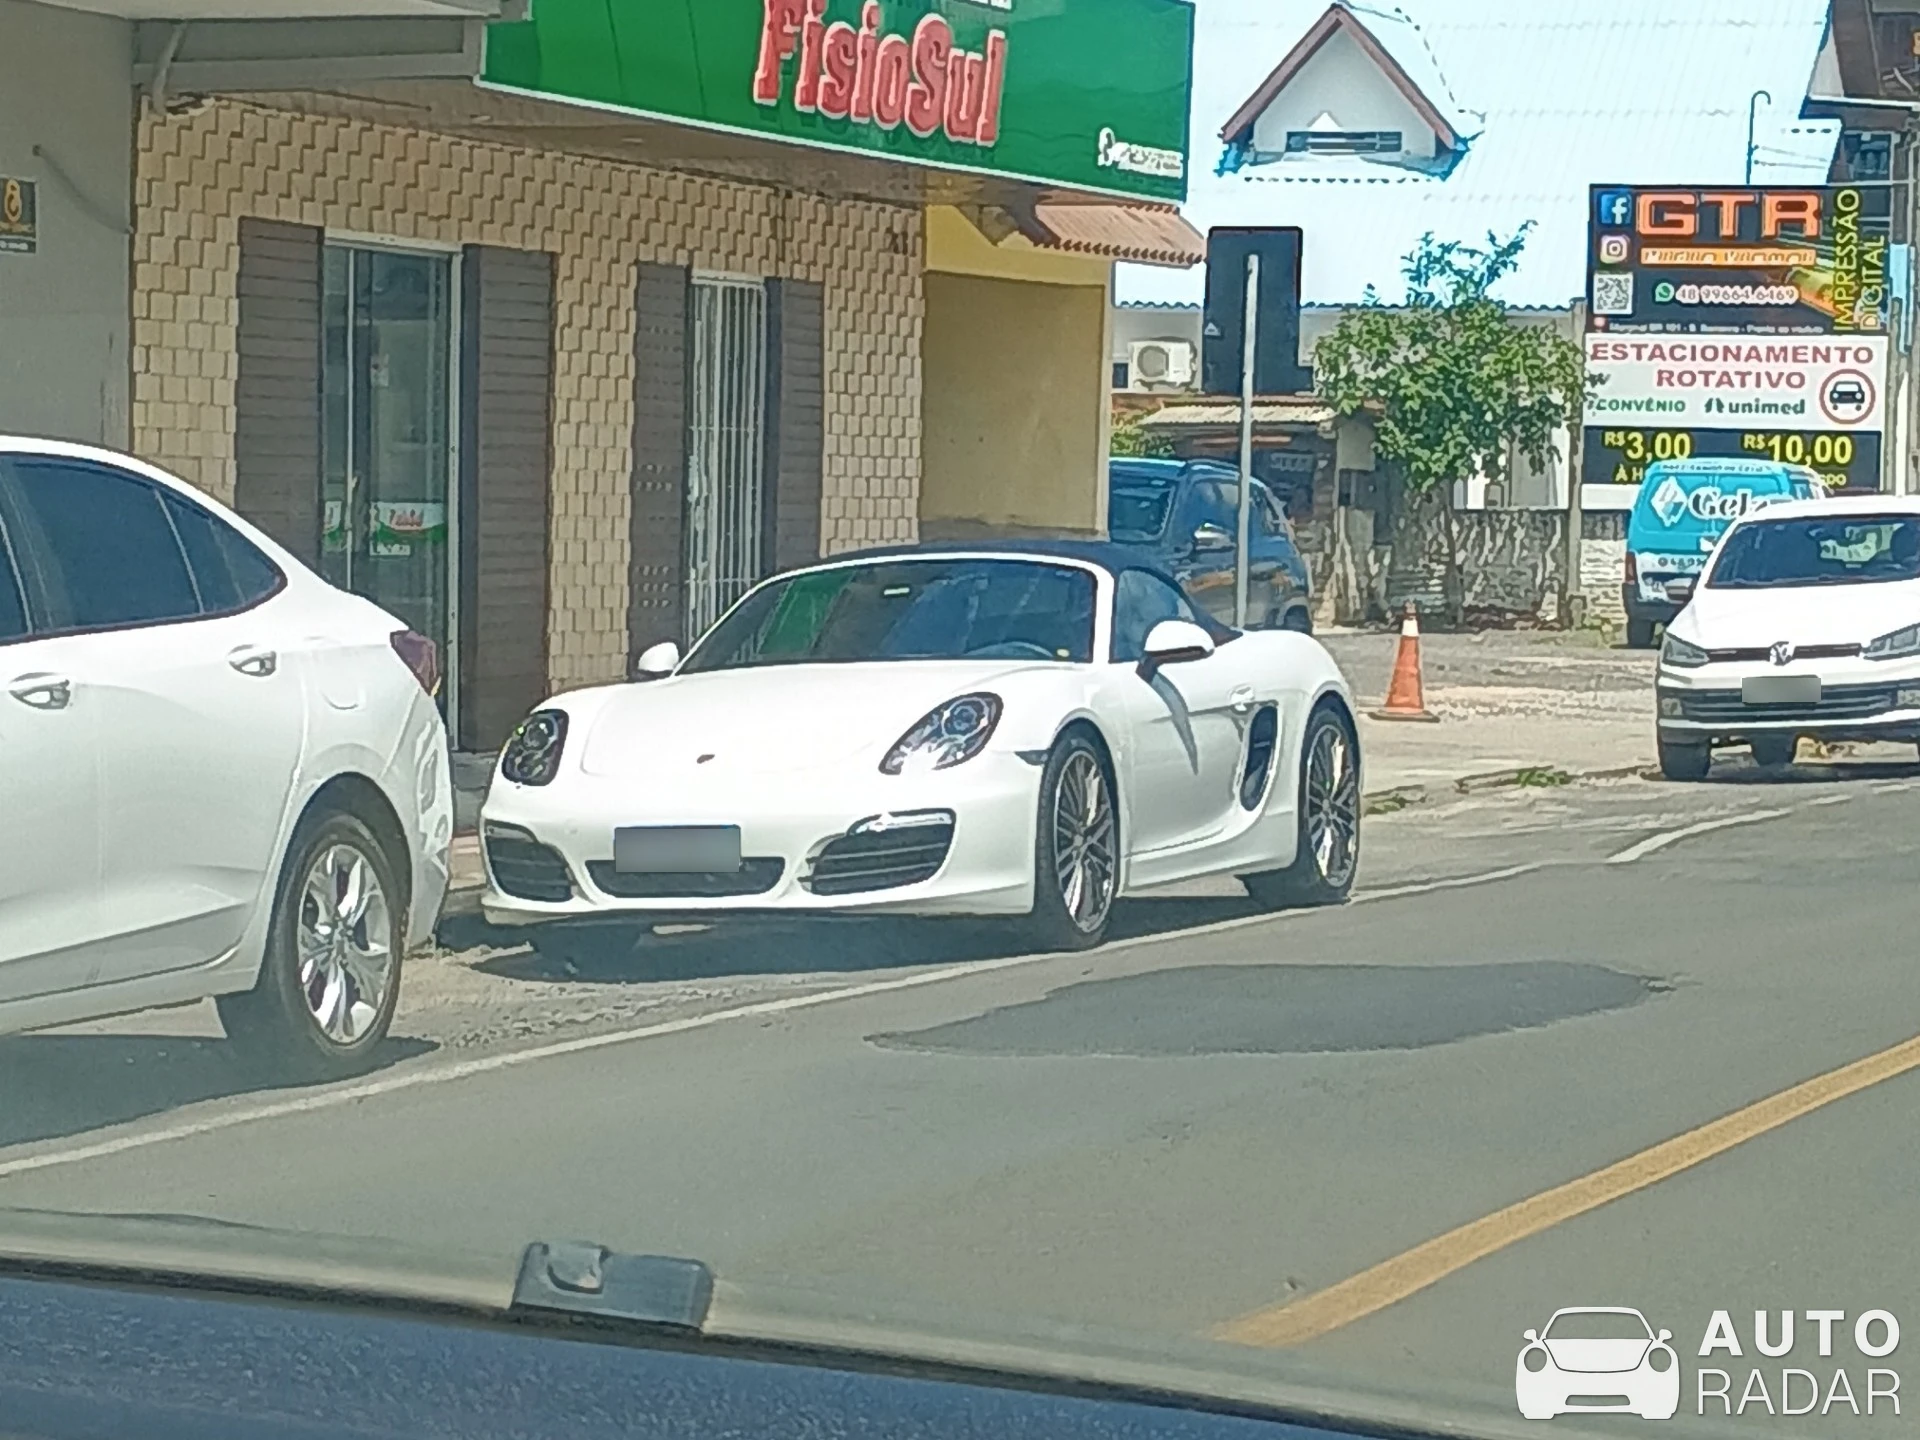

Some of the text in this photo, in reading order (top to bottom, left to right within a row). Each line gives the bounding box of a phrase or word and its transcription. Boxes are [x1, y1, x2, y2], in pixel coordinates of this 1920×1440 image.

[753, 0, 1006, 147] FisioSul
[1637, 193, 1822, 236] GTR
[1832, 189, 1859, 331] IMPRESSÃO
[1860, 235, 1885, 331] DIGITAL
[1590, 343, 1874, 364] ESTACIONAMENTO
[1656, 369, 1806, 389] ROTATIVO
[1728, 398, 1806, 415] unimed
